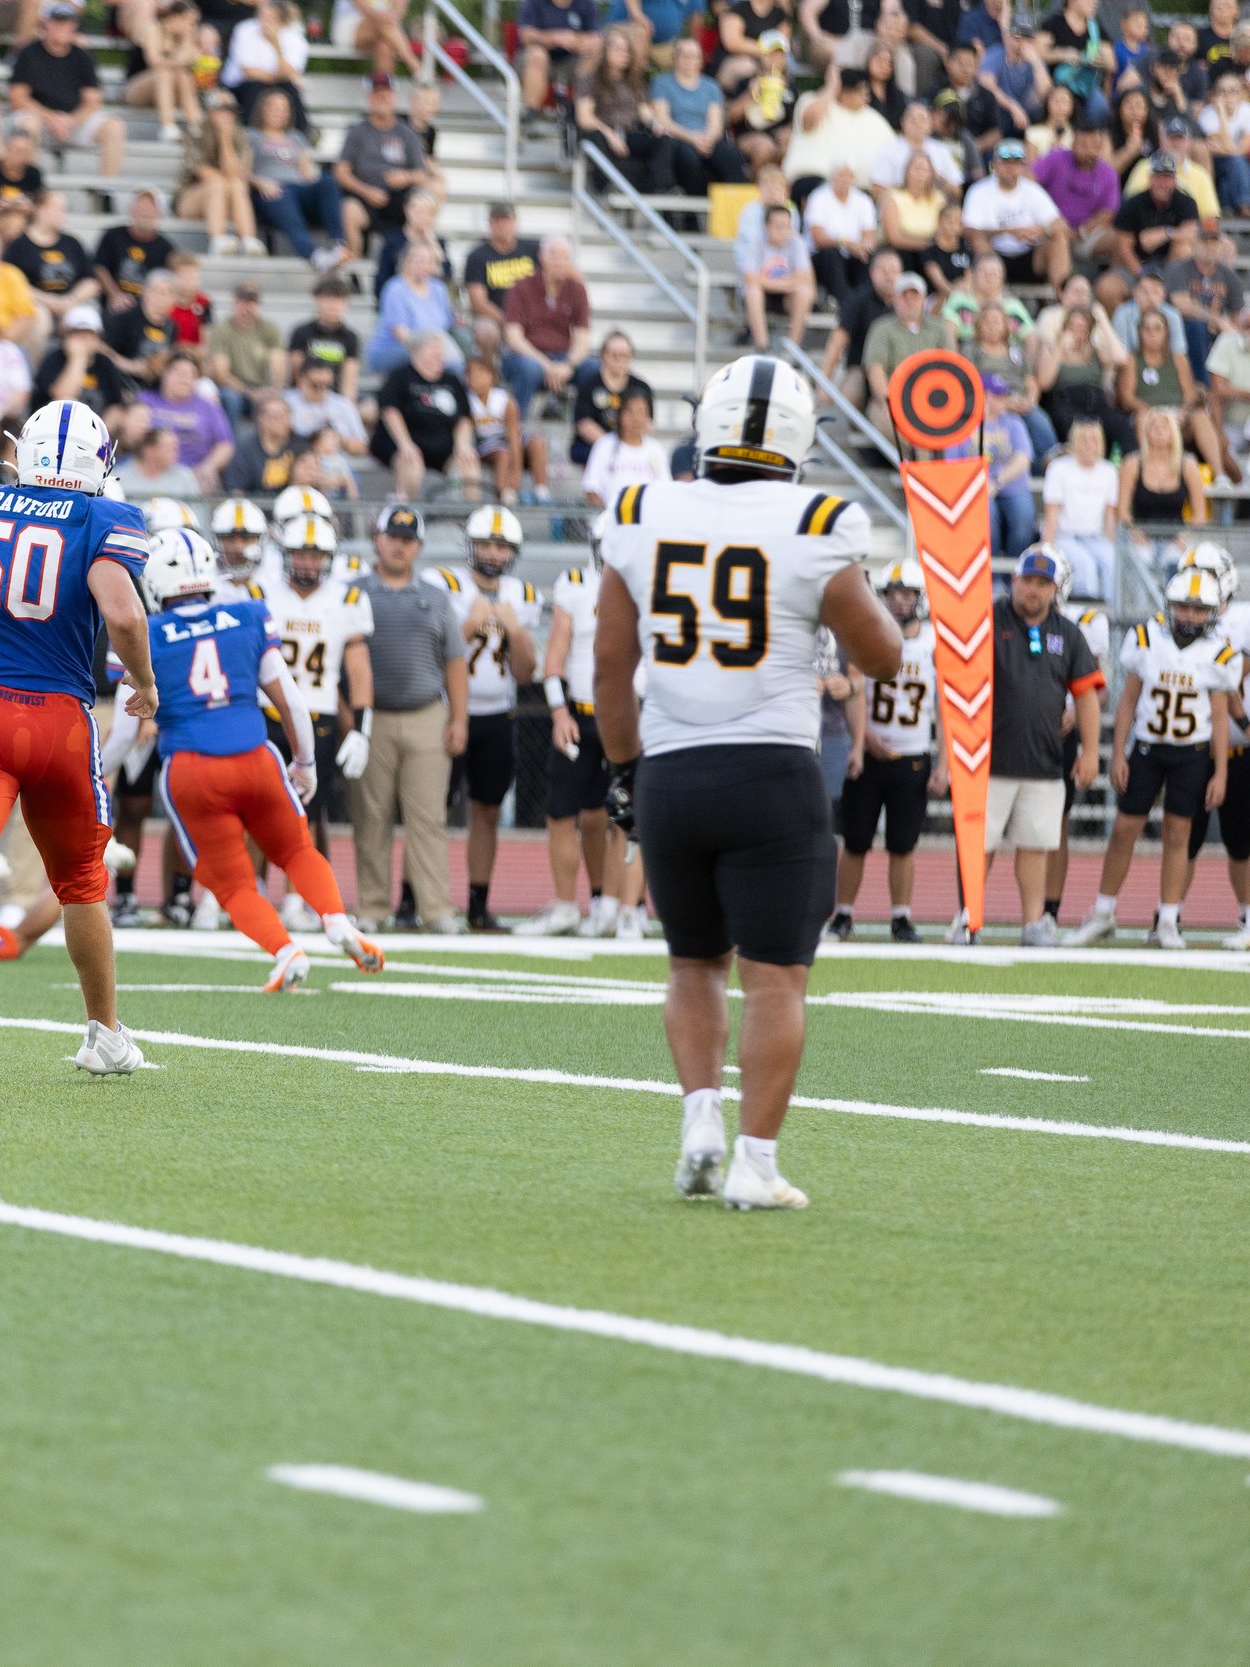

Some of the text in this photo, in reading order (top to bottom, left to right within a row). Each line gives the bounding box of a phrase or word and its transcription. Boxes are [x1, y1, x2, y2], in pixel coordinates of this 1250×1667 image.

[161, 610, 241, 643] LEA
[650, 540, 770, 670] 59
[188, 637, 231, 711] 4
[872, 680, 927, 727] 63
[1147, 687, 1199, 739] 35
